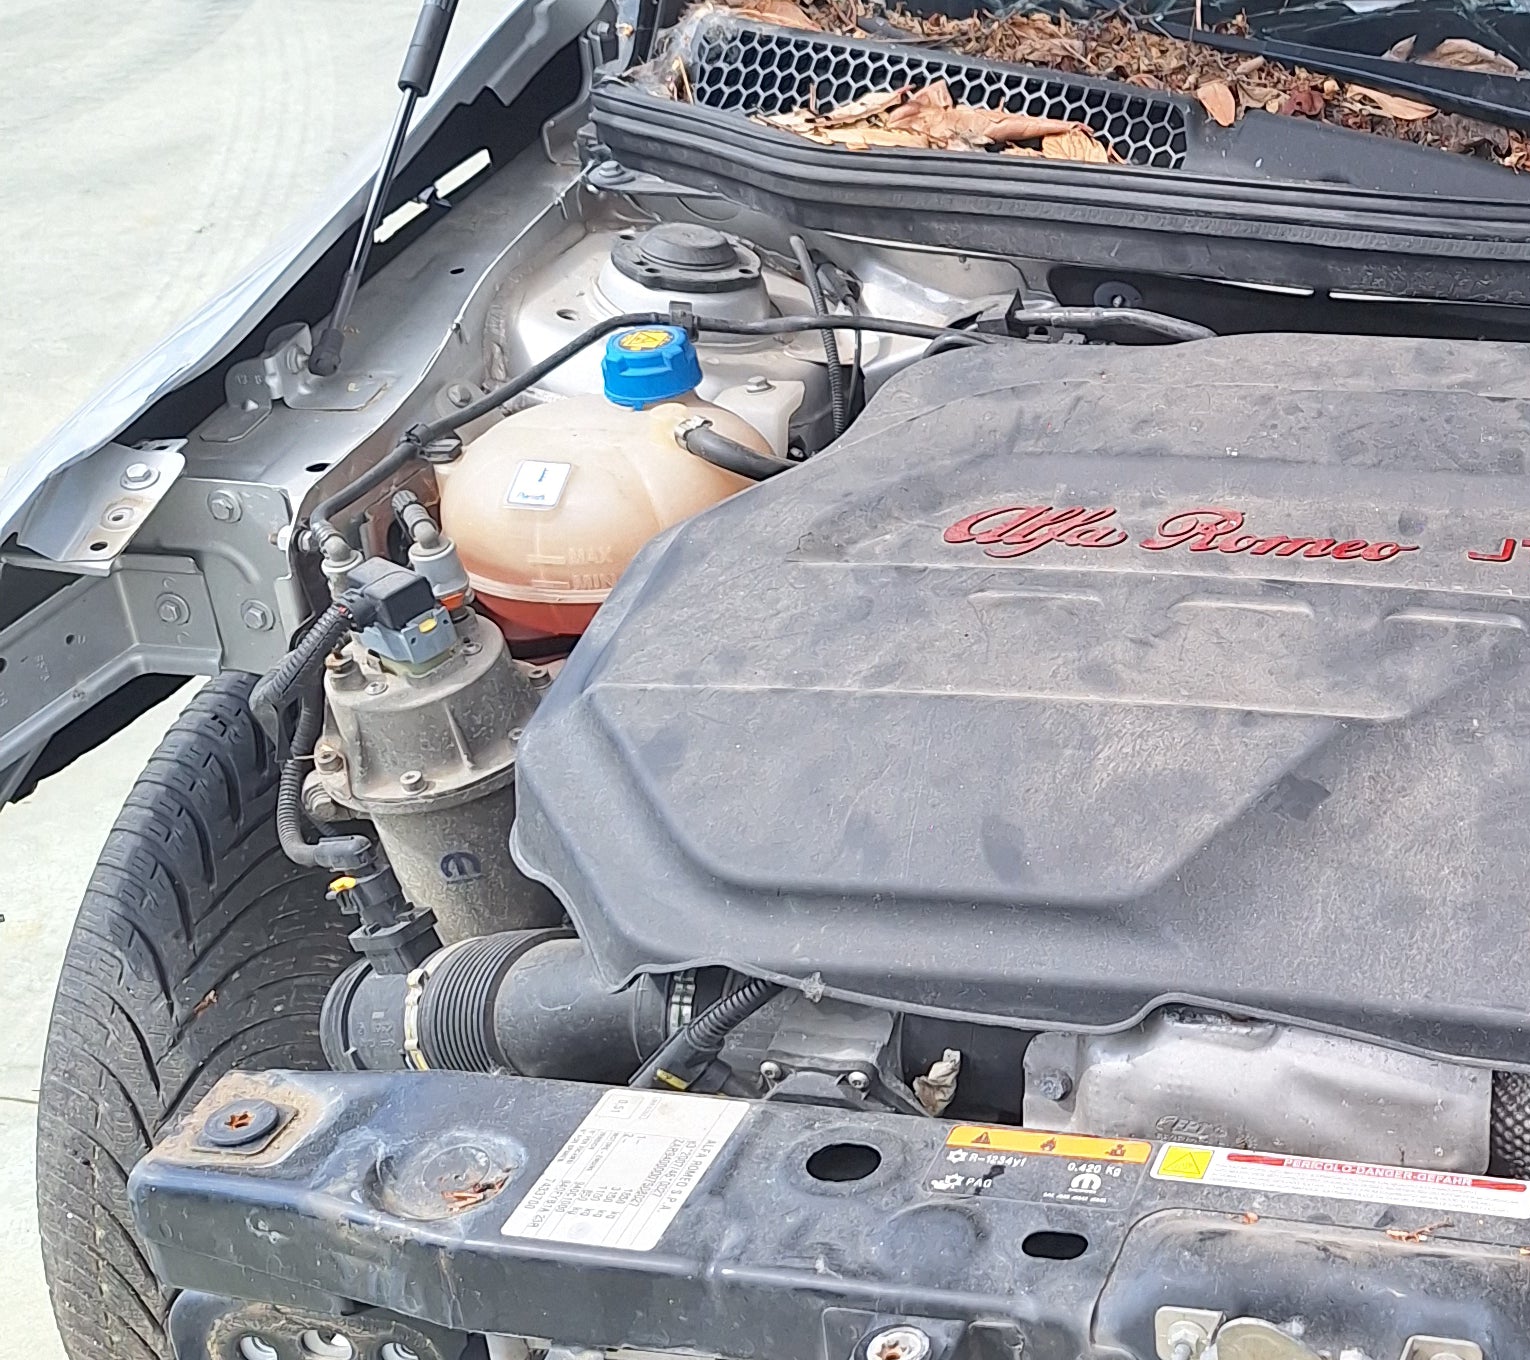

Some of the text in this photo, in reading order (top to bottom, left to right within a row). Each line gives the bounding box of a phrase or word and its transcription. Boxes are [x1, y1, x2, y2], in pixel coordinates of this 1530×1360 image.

[942, 504, 1128, 559] Alfa
[1139, 507, 1422, 562] Romeo
[696, 1139, 717, 1158] ALFA
[676, 1160, 702, 1187] ROMEO
[968, 1153, 1121, 1177] R-1234yf 0.420 Kg
[965, 1178, 992, 1188] PAG
